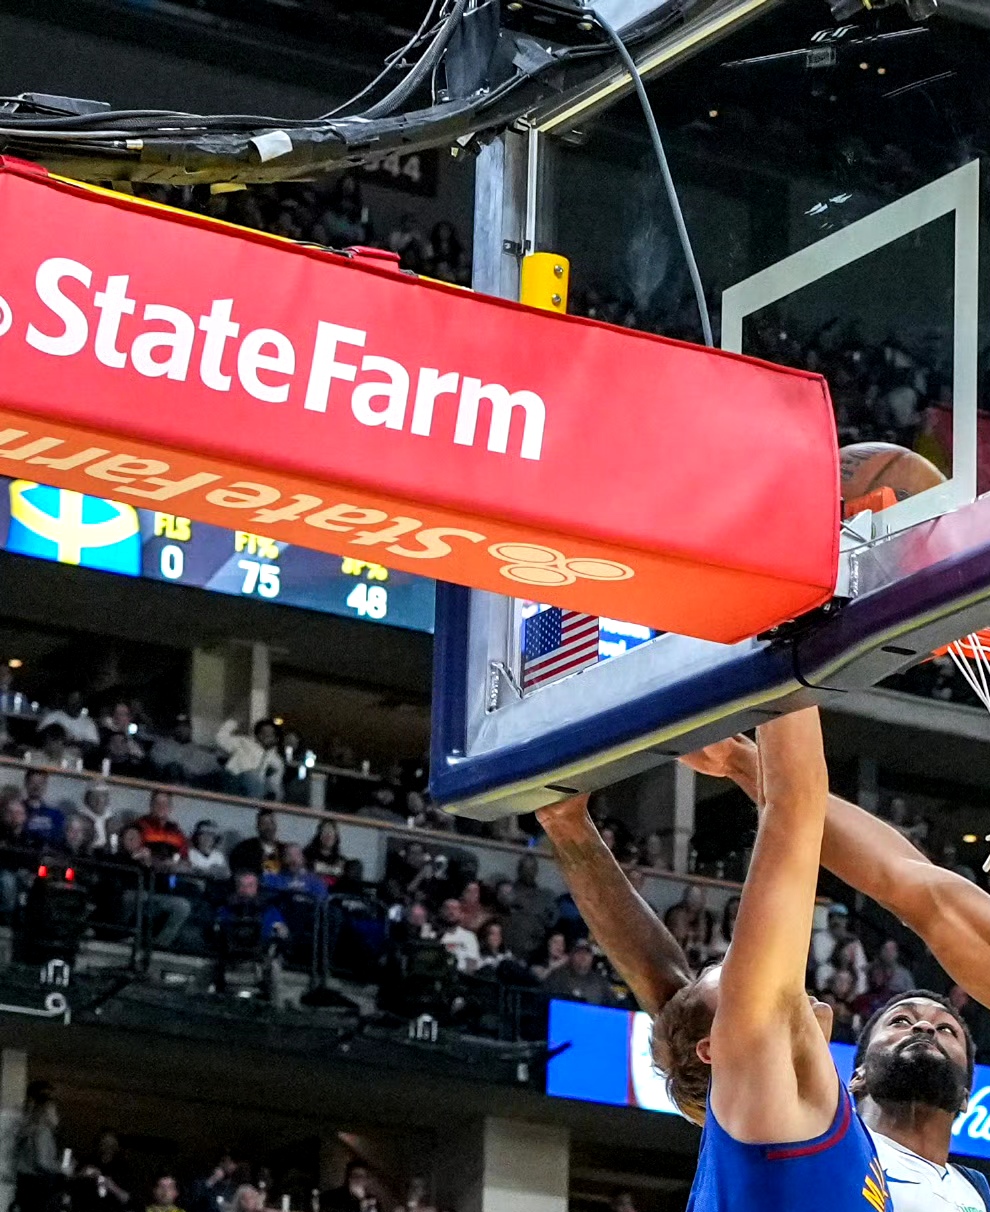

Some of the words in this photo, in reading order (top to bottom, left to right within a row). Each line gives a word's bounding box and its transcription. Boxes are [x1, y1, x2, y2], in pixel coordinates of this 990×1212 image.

[160, 545, 184, 579] 0
[237, 559, 281, 599] 75
[346, 583, 388, 619] 48
